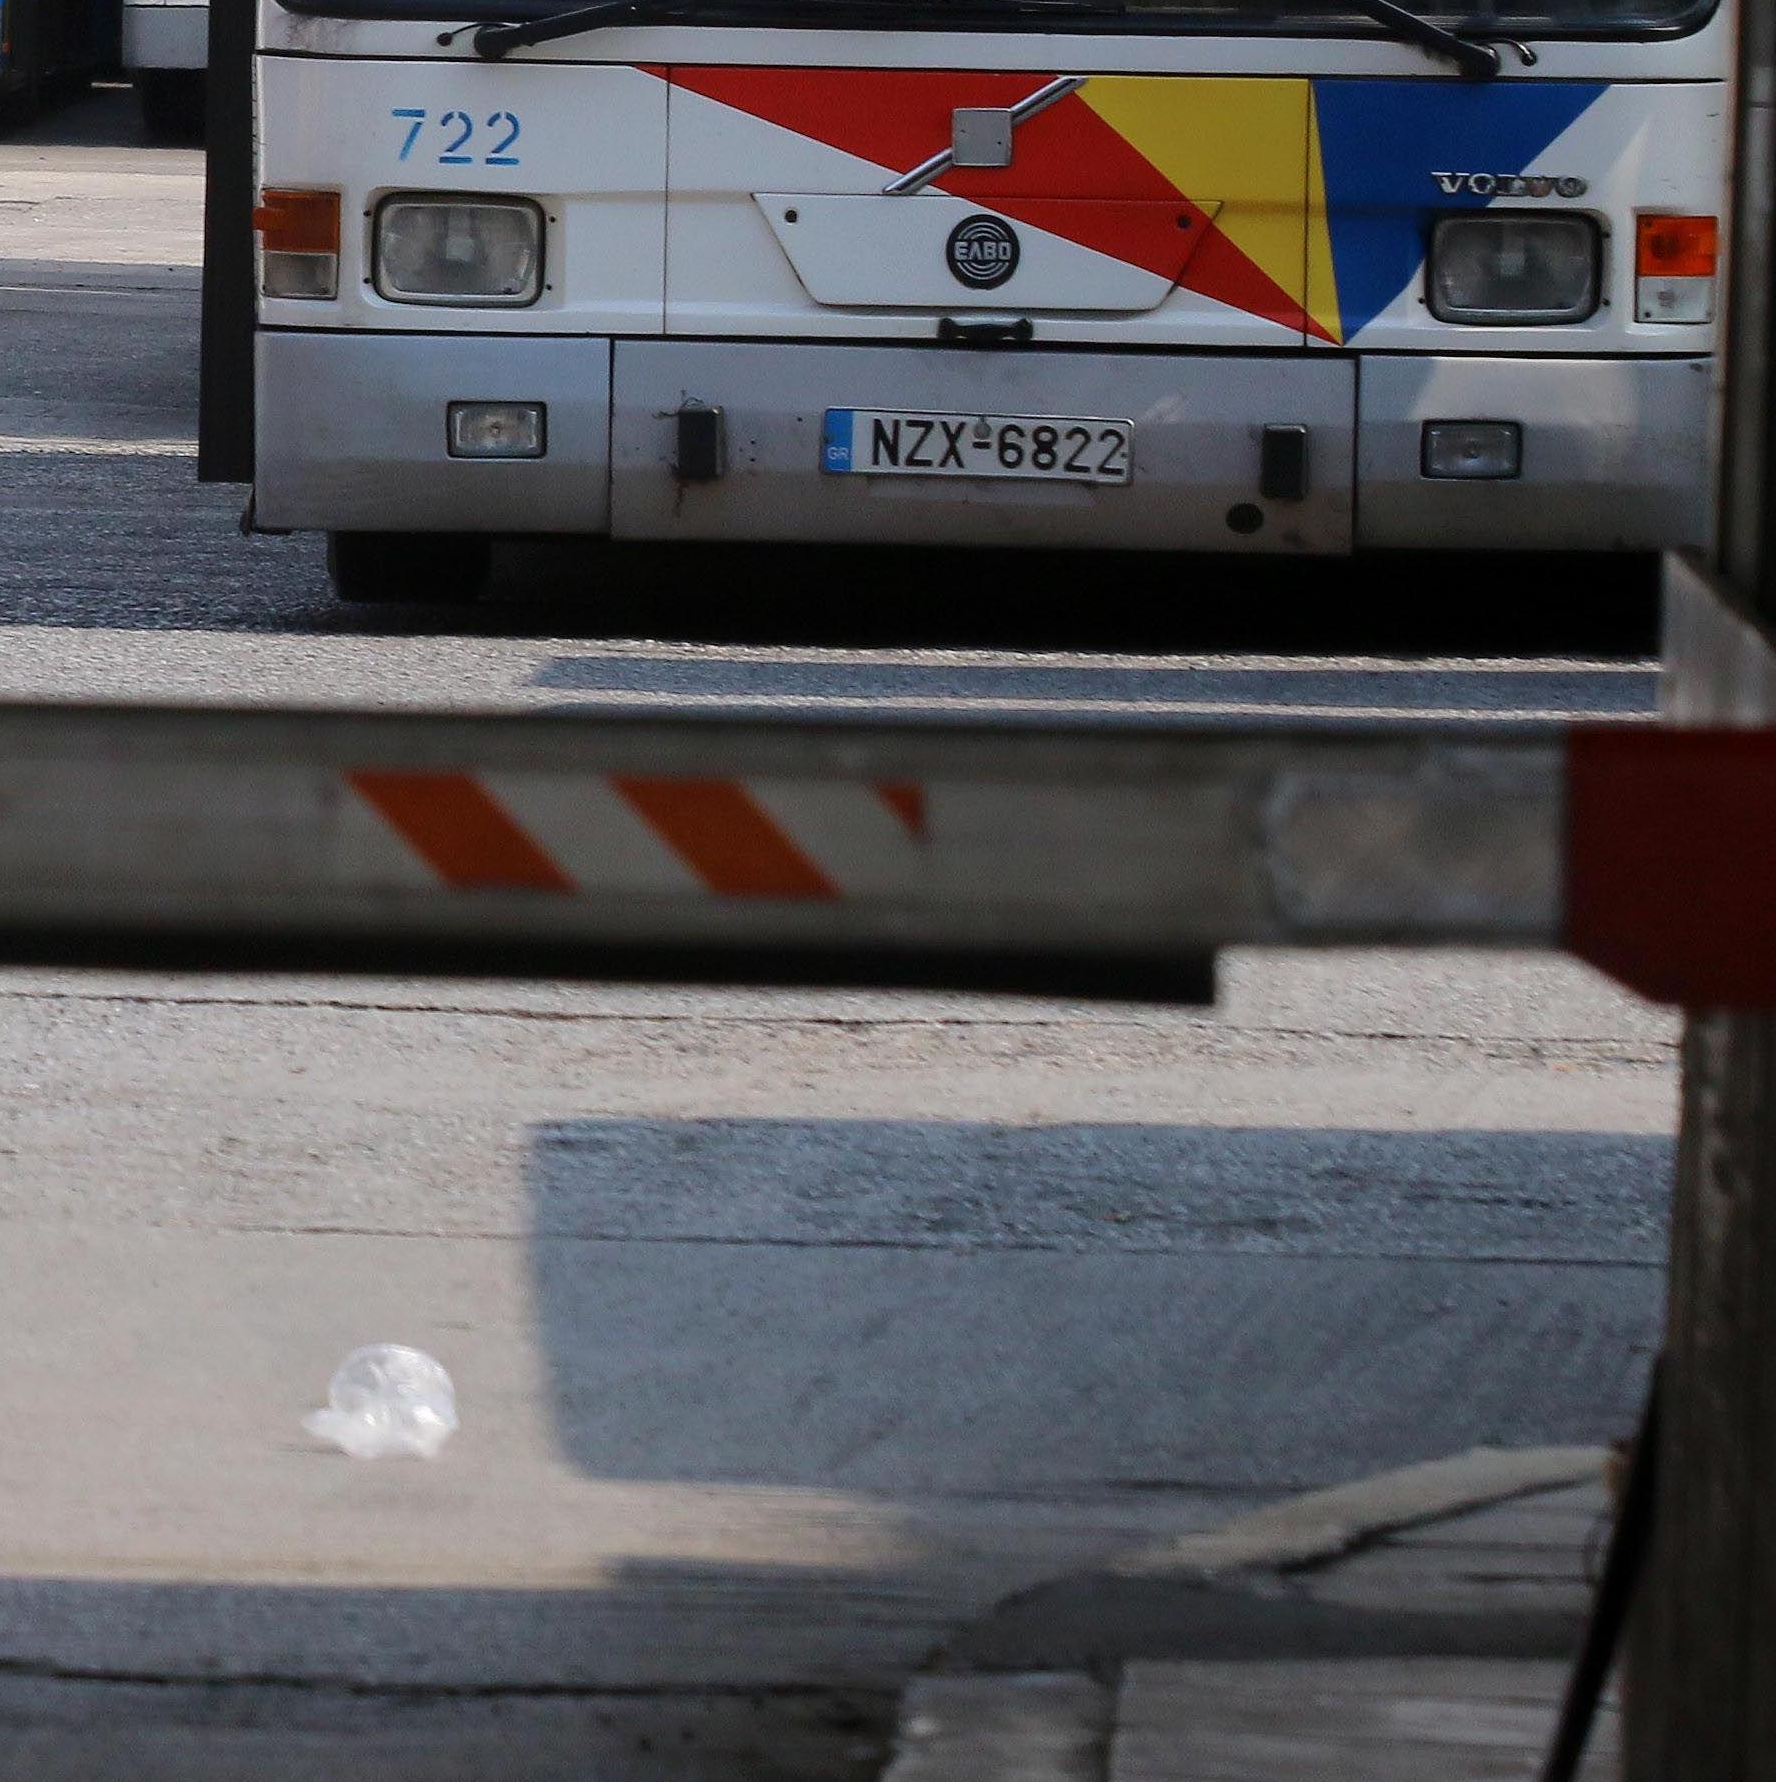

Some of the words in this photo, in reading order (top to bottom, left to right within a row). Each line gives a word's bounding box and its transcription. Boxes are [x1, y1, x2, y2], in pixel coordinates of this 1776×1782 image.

[392, 108, 520, 166] 722
[1430, 172, 1589, 198] VOLVO
[827, 447, 849, 461] GR
[871, 417, 1126, 476] NZX-6822
